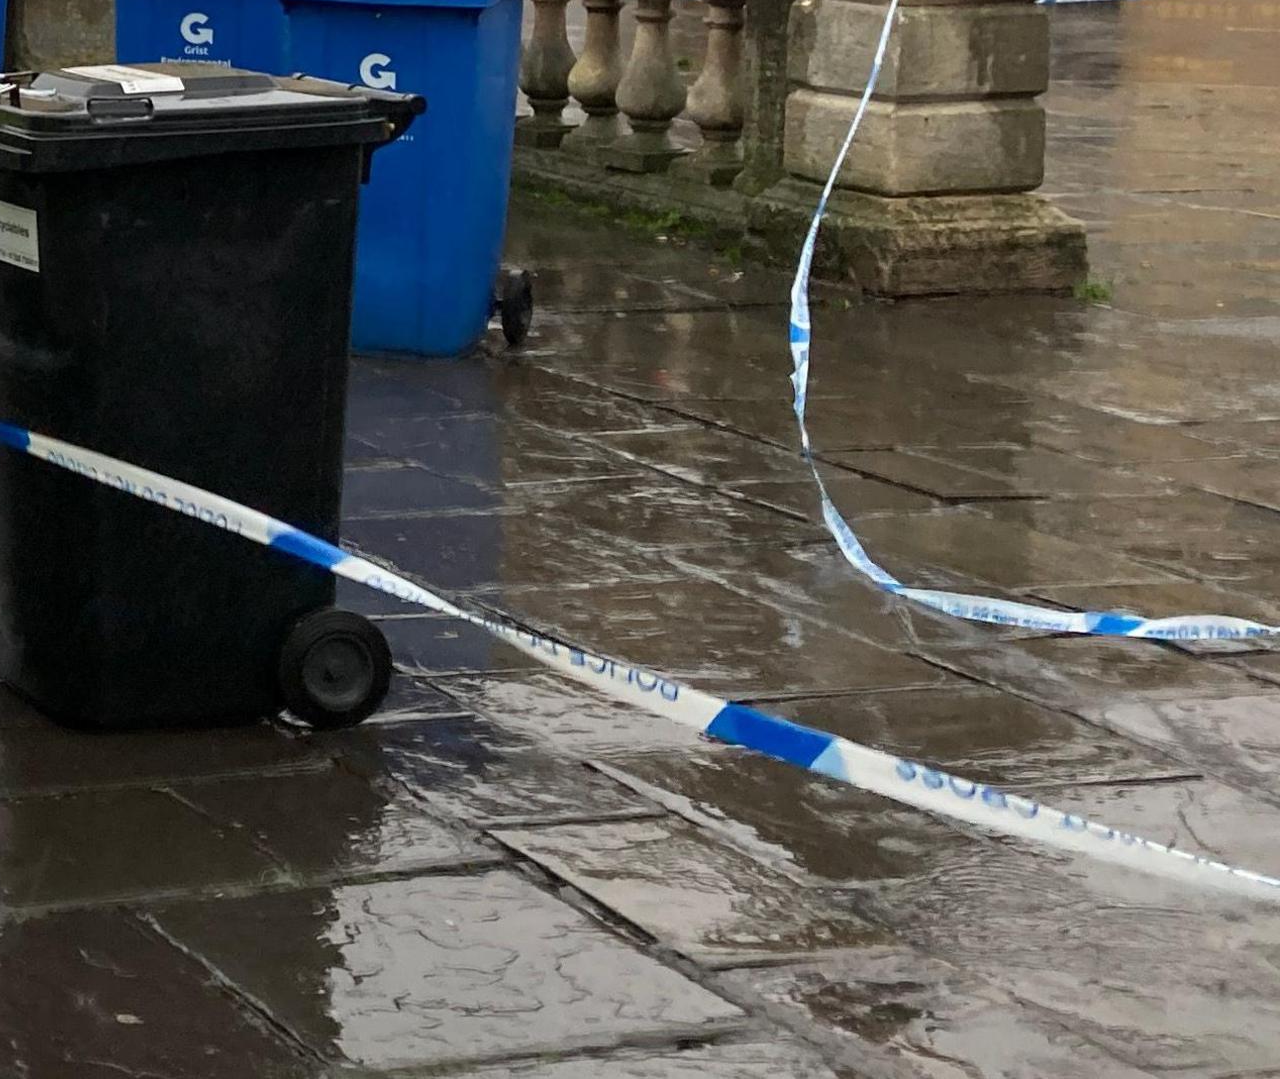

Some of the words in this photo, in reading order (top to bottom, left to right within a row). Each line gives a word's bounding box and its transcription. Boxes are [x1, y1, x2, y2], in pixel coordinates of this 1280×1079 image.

[180, 12, 214, 45] G
[184, 46, 209, 56] Grist
[359, 53, 397, 90] G
